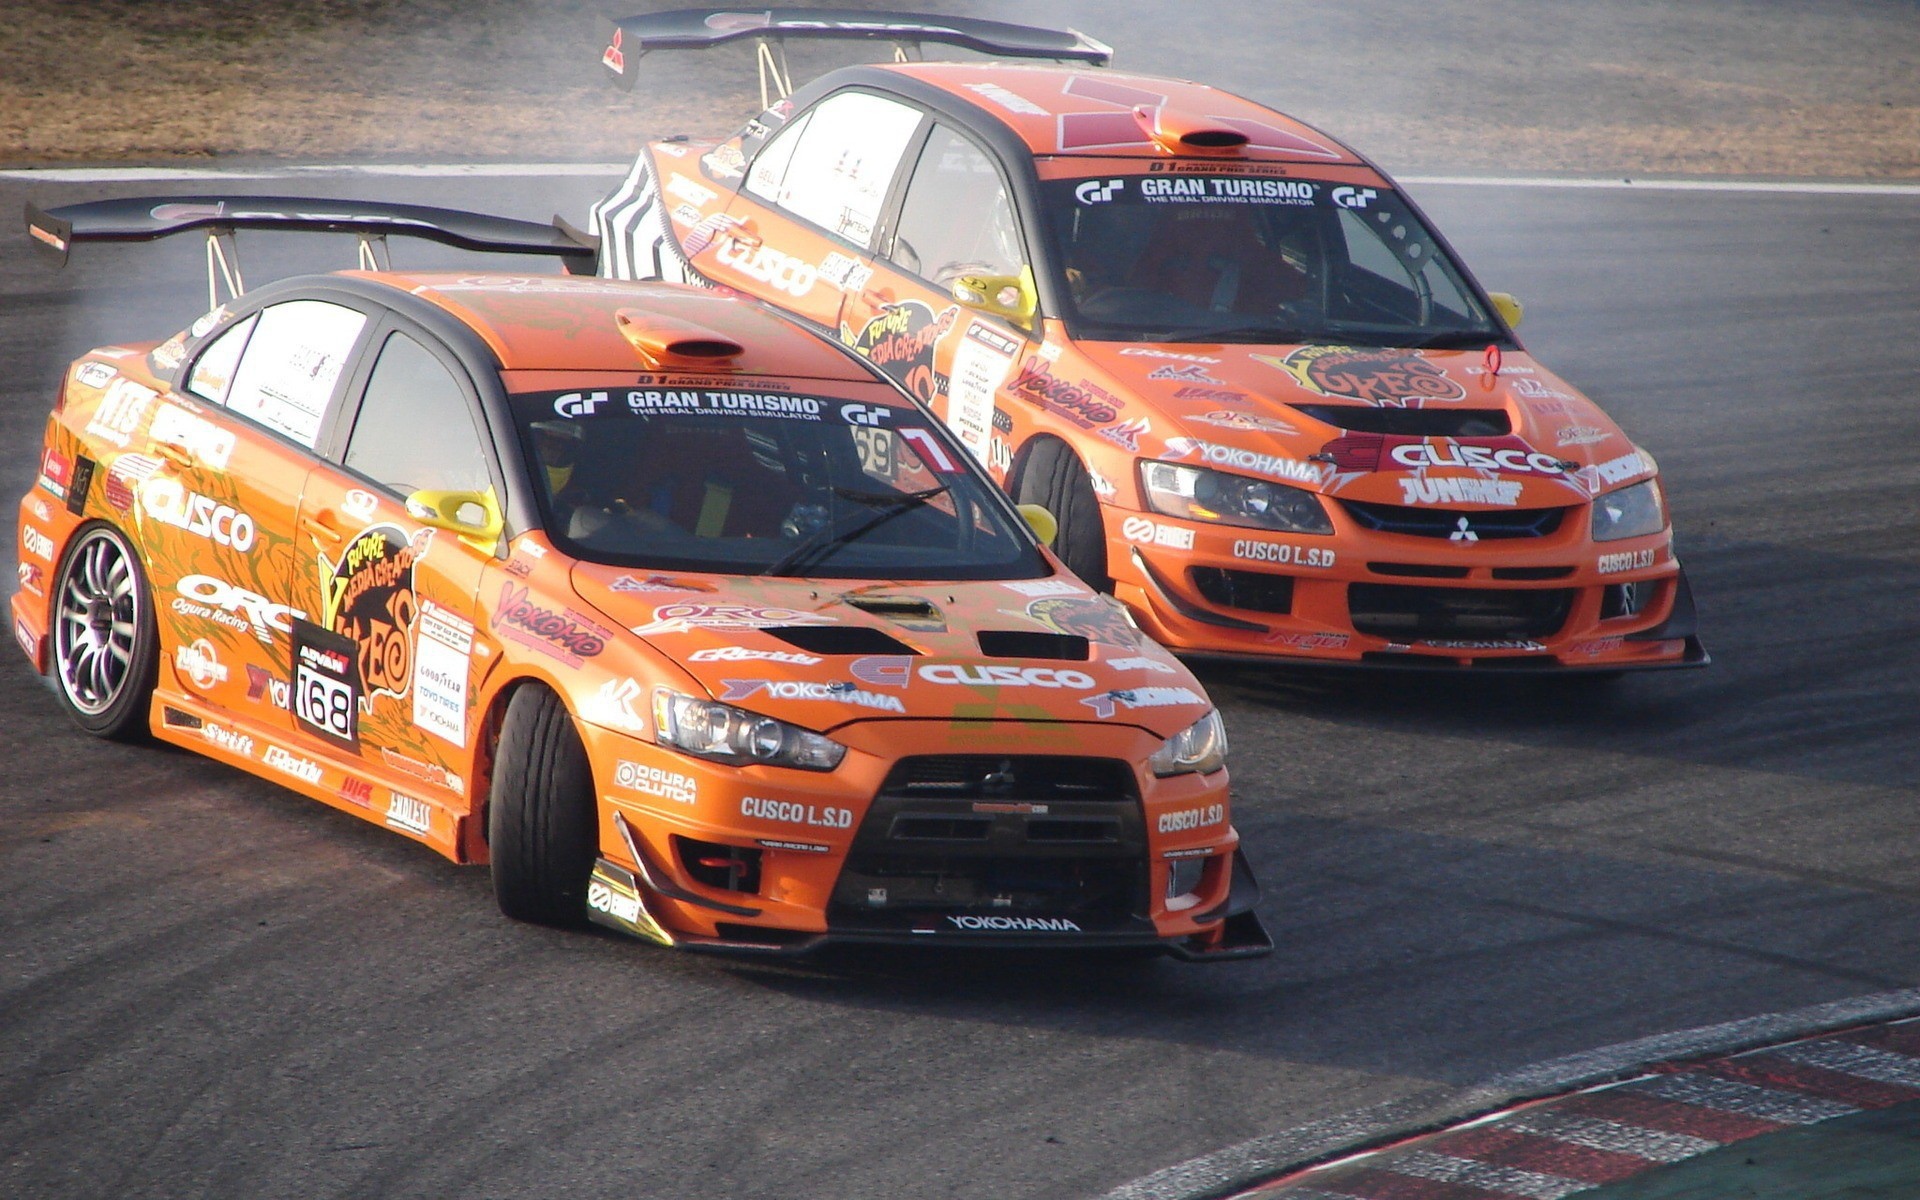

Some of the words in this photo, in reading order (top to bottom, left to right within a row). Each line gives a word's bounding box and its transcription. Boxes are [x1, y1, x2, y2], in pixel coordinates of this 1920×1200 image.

[1140, 178, 1206, 196] GRAN
[1210, 179, 1314, 199] TURISMO
[1201, 196, 1250, 204] DRIVING
[1250, 197, 1315, 206] SIMULATOR
[627, 391, 700, 408] GRAN
[705, 392, 820, 415] TURISMO
[631, 407, 660, 415] THE
[660, 407, 694, 416] REAL
[694, 408, 747, 417] DRIVING
[748, 409, 822, 421] SIMULATOR
[1201, 440, 1322, 484] YOKOHAMA
[1391, 443, 1567, 475] CUSCO
[142, 478, 255, 552] CUSCO
[1233, 539, 1291, 564] CUSCO
[1294, 547, 1336, 568] L.S.D
[1597, 551, 1632, 574] CUSCO
[171, 597, 212, 620] Ogura
[212, 608, 250, 633] Racing
[300, 645, 345, 674] ADVAN
[420, 665, 461, 694] GOODYEAR
[918, 664, 1097, 690] CUSCO
[299, 673, 350, 736] 168
[419, 686, 438, 703] TOYO
[203, 722, 255, 755] Swift
[634, 777, 697, 805] CLUTCH
[636, 764, 697, 790] OGURA
[741, 796, 804, 823] CUSCO
[806, 806, 853, 829] L.S.D
[1158, 808, 1199, 834] CUSCO
[947, 915, 1082, 932] YOKOHAMA
